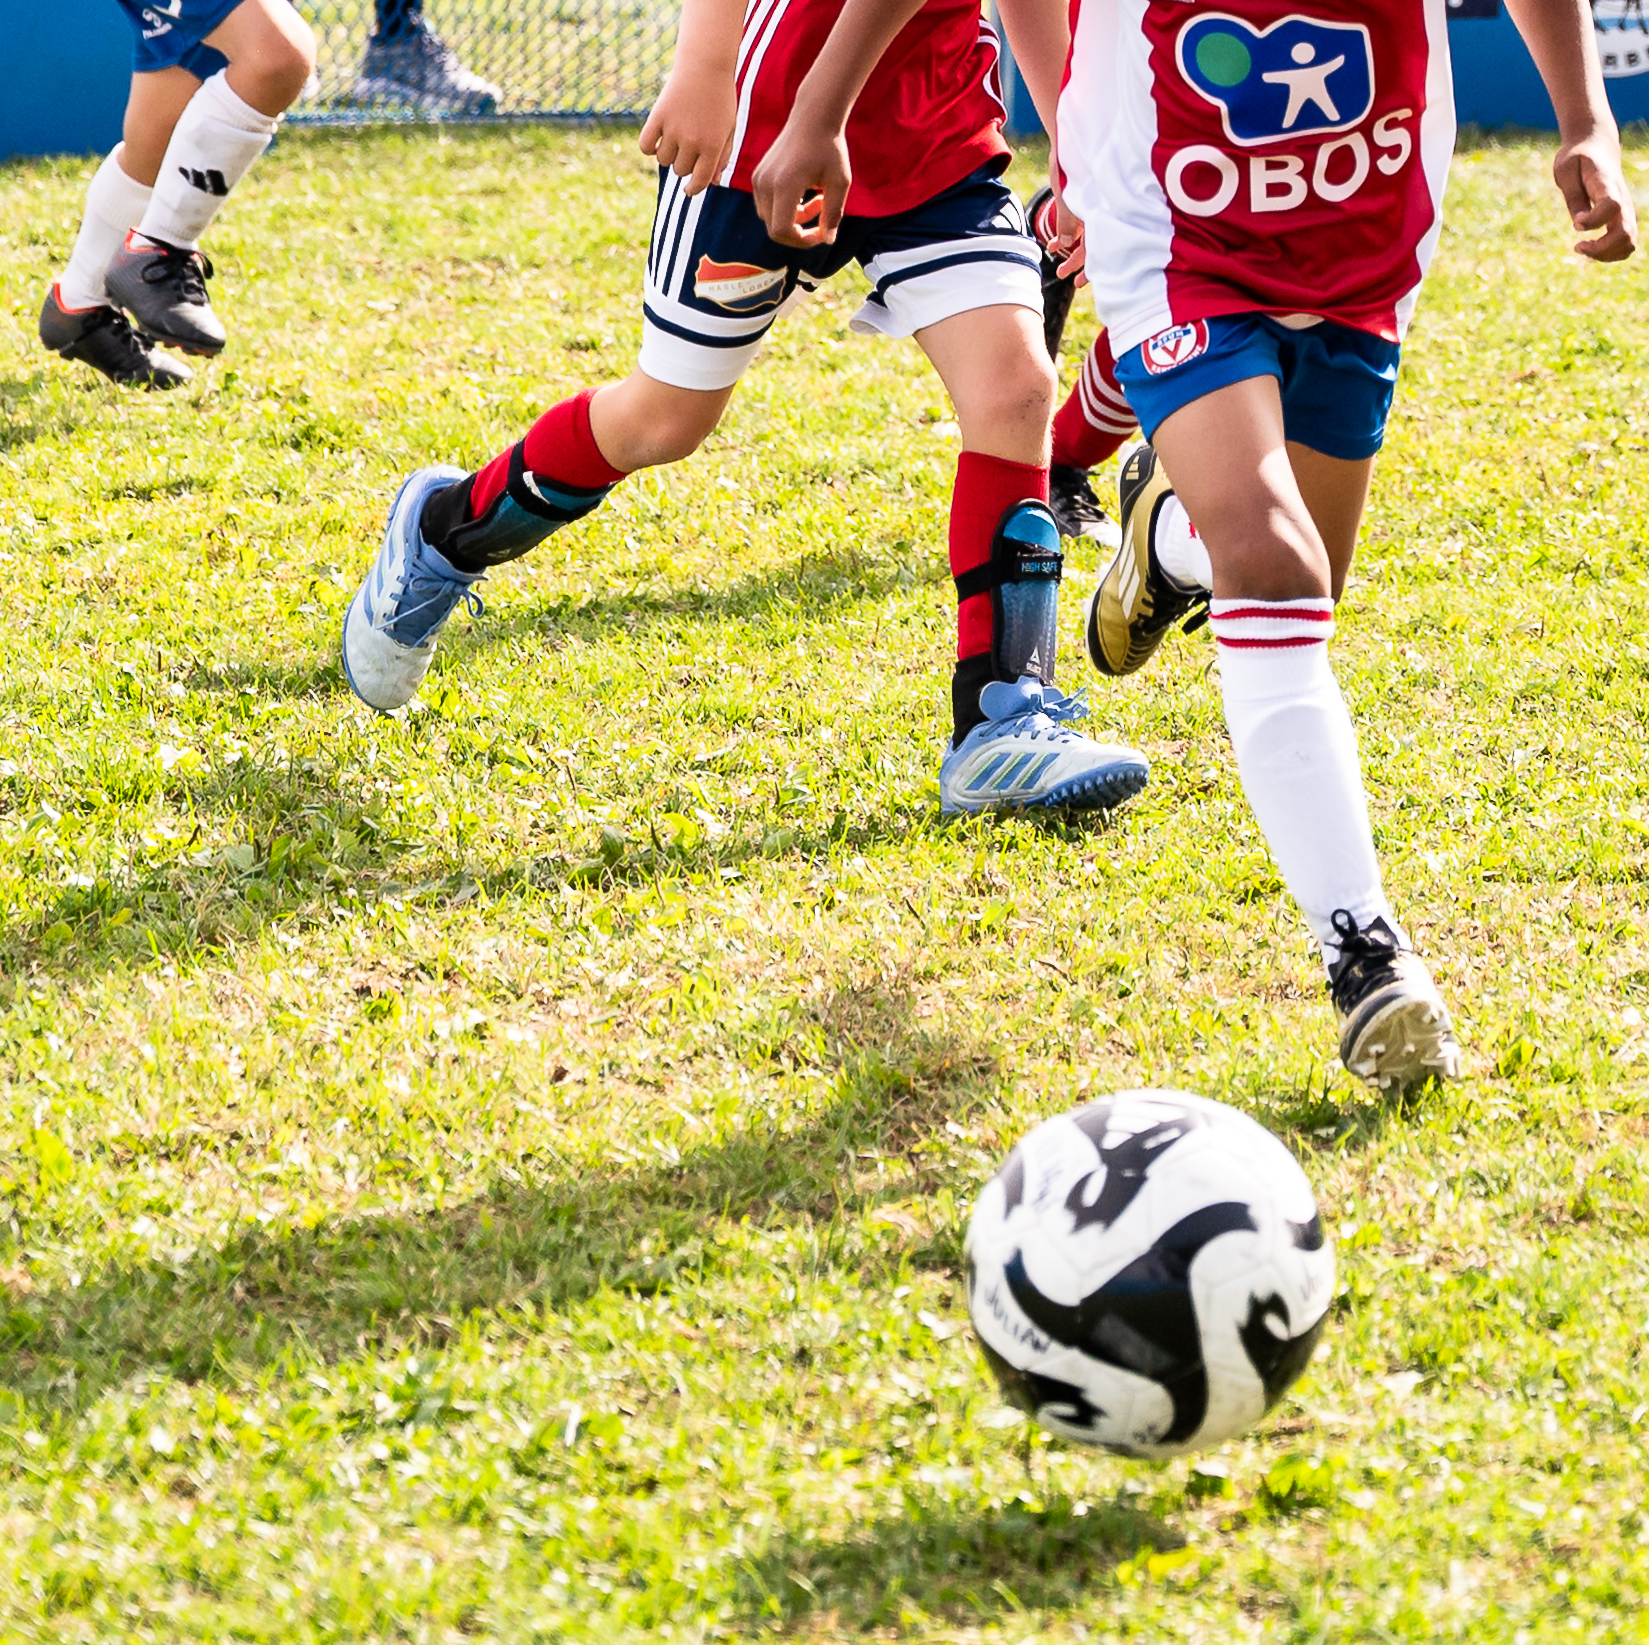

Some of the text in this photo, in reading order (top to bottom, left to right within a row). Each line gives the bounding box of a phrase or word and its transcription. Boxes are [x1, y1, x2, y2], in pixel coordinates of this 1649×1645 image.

[1164, 107, 1414, 218] OBOS
[1021, 561, 1059, 574] HIGH SAFE
